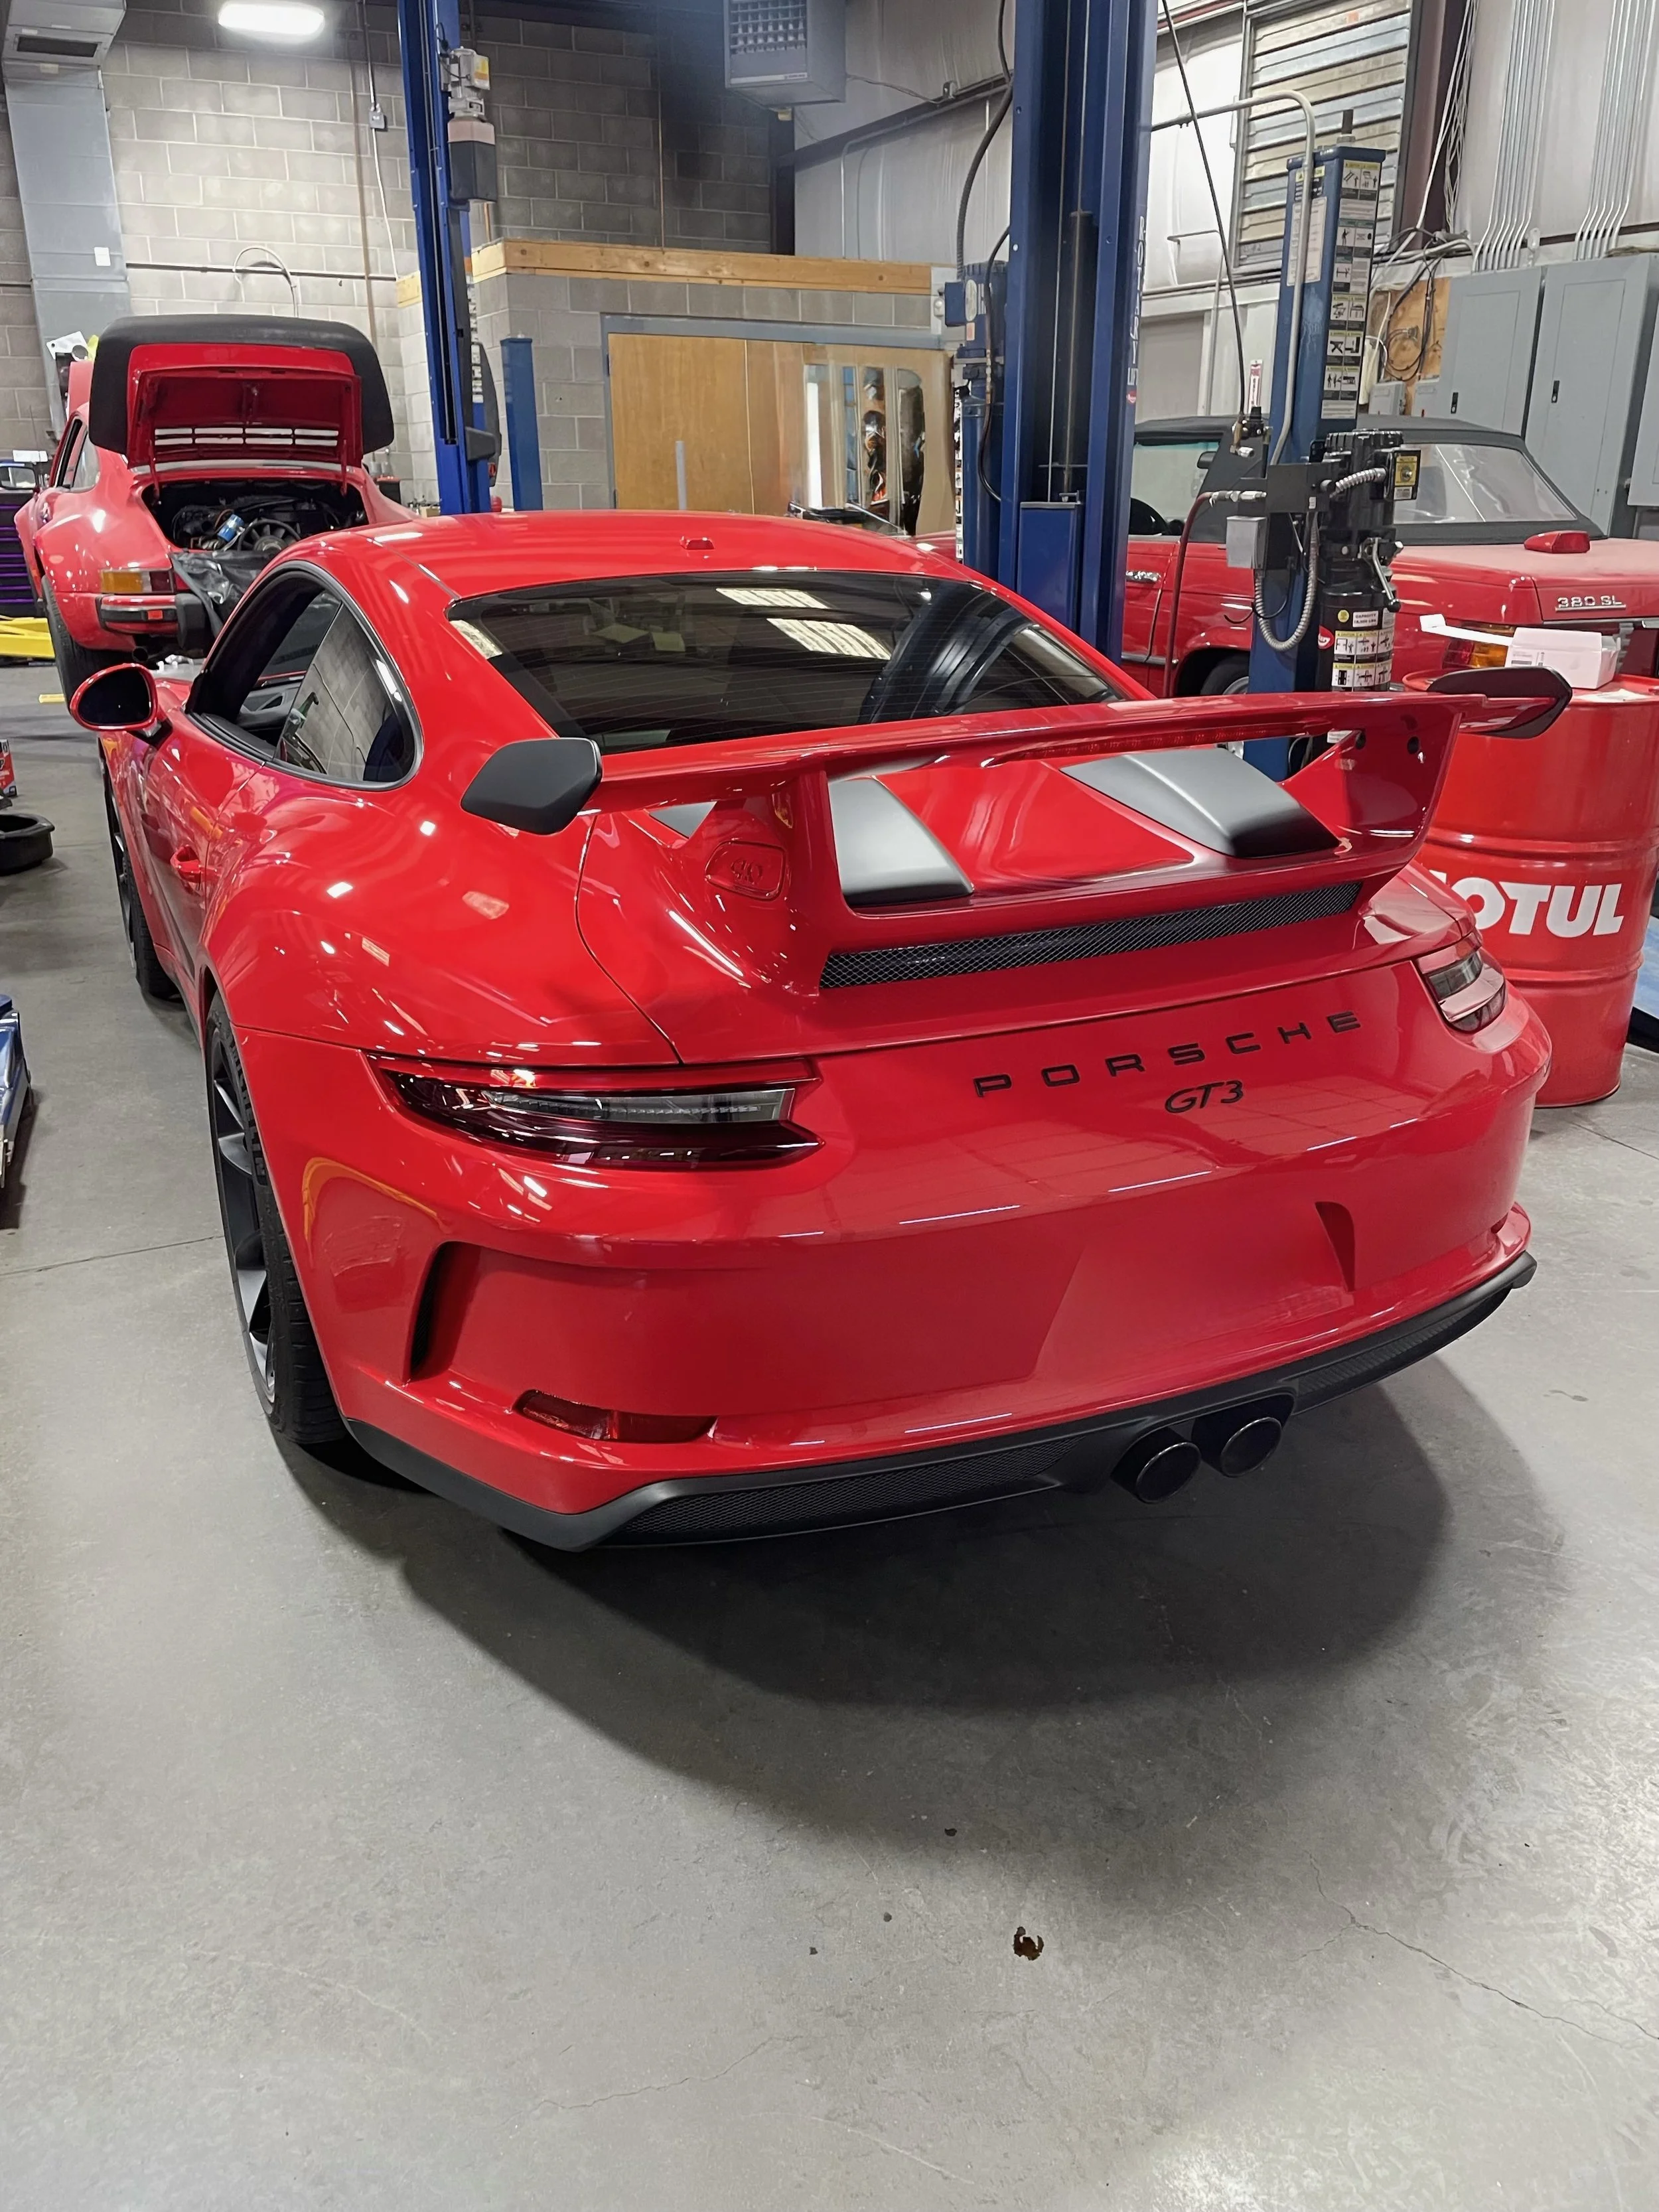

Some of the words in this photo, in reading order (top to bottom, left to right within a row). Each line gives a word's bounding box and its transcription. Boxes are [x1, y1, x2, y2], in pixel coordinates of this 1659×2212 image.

[1129, 216, 1145, 364] ROTARY
[1557, 596, 1595, 608] 380
[1600, 595, 1622, 606] SL
[1429, 870, 1624, 938] OTUL
[973, 1011, 1361, 1098] PORSCHE
[1164, 1080, 1244, 1114] GT3
